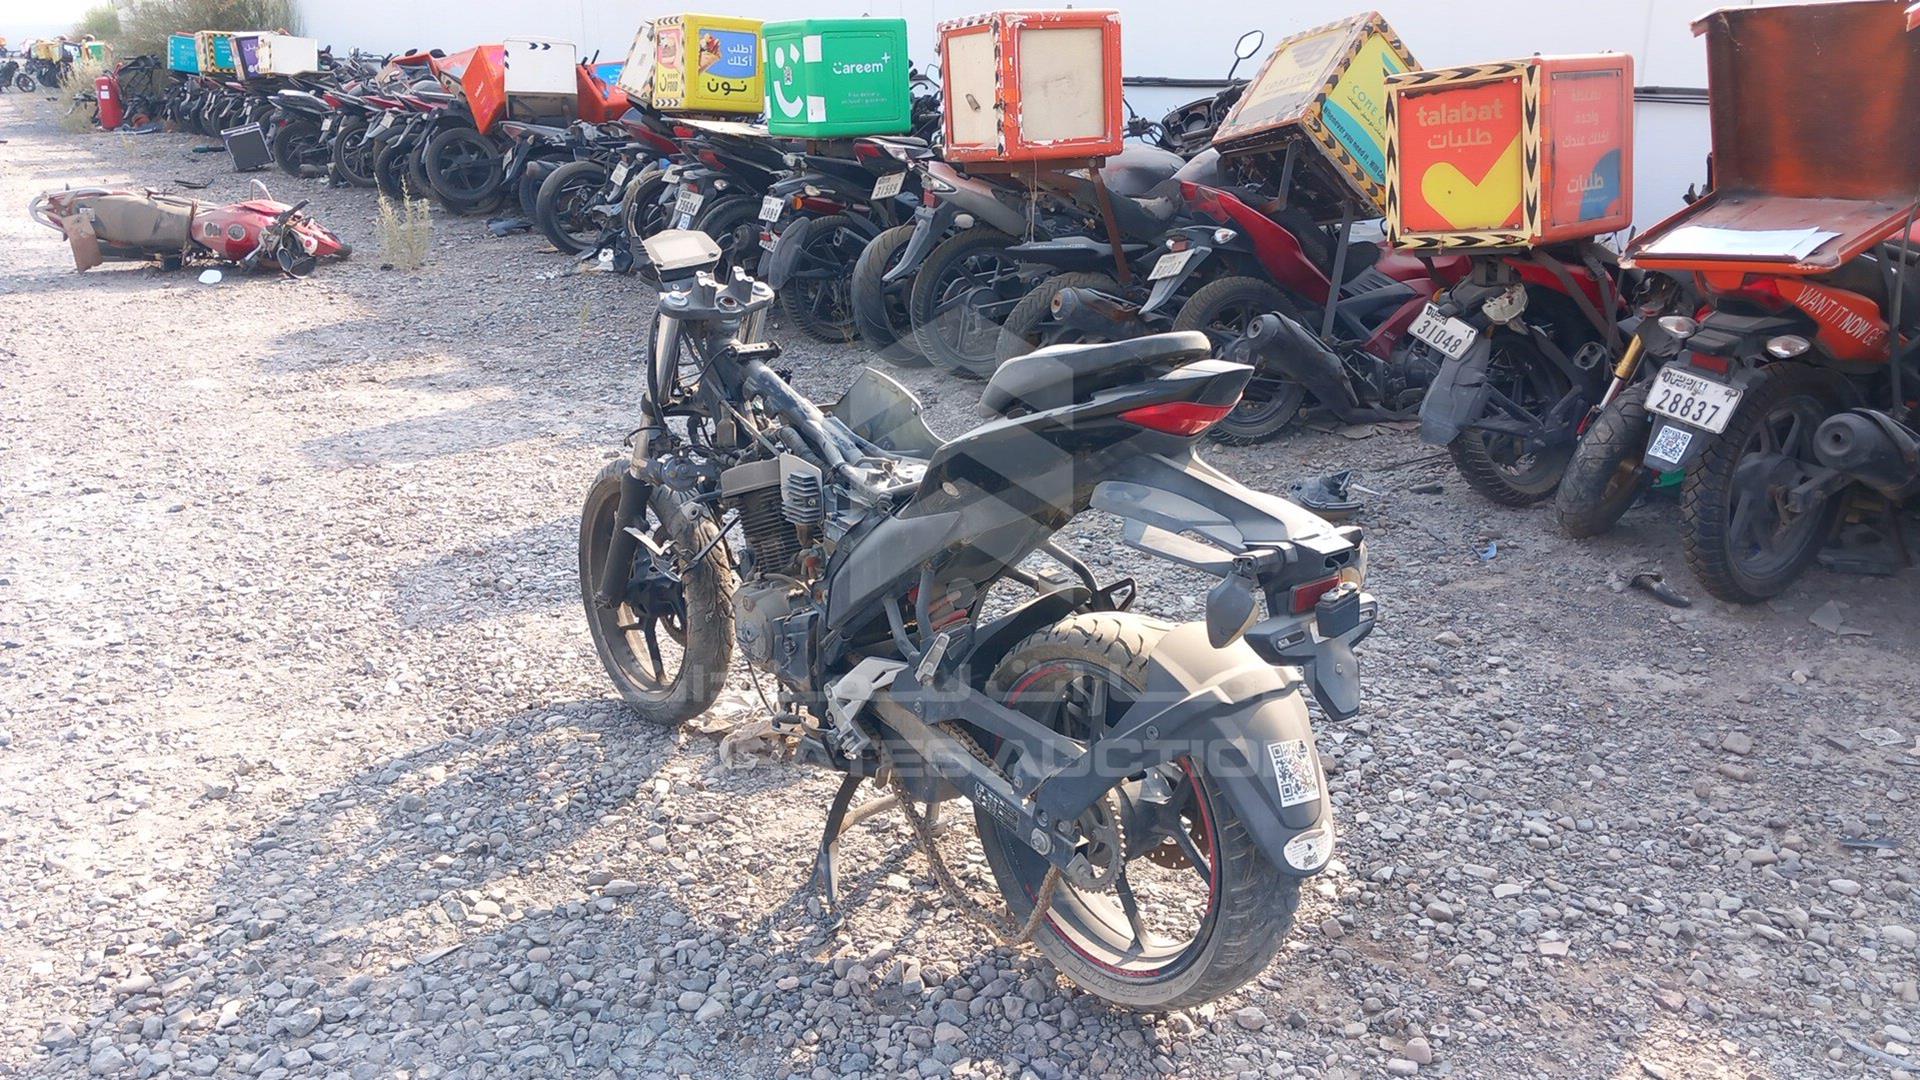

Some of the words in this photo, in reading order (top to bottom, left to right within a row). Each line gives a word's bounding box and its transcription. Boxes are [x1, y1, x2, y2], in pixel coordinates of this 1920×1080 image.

[707, 78, 747, 96] نون
[1416, 98, 1504, 127] talabat
[1427, 128, 1493, 152] طلبات
[1567, 172, 1604, 195] طلبات
[1795, 285, 1837, 318] WANT
[1827, 305, 1849, 324] IT
[1838, 312, 1872, 339] NOW
[1417, 320, 1462, 353] 31048
[1655, 388, 1720, 425] 28837
